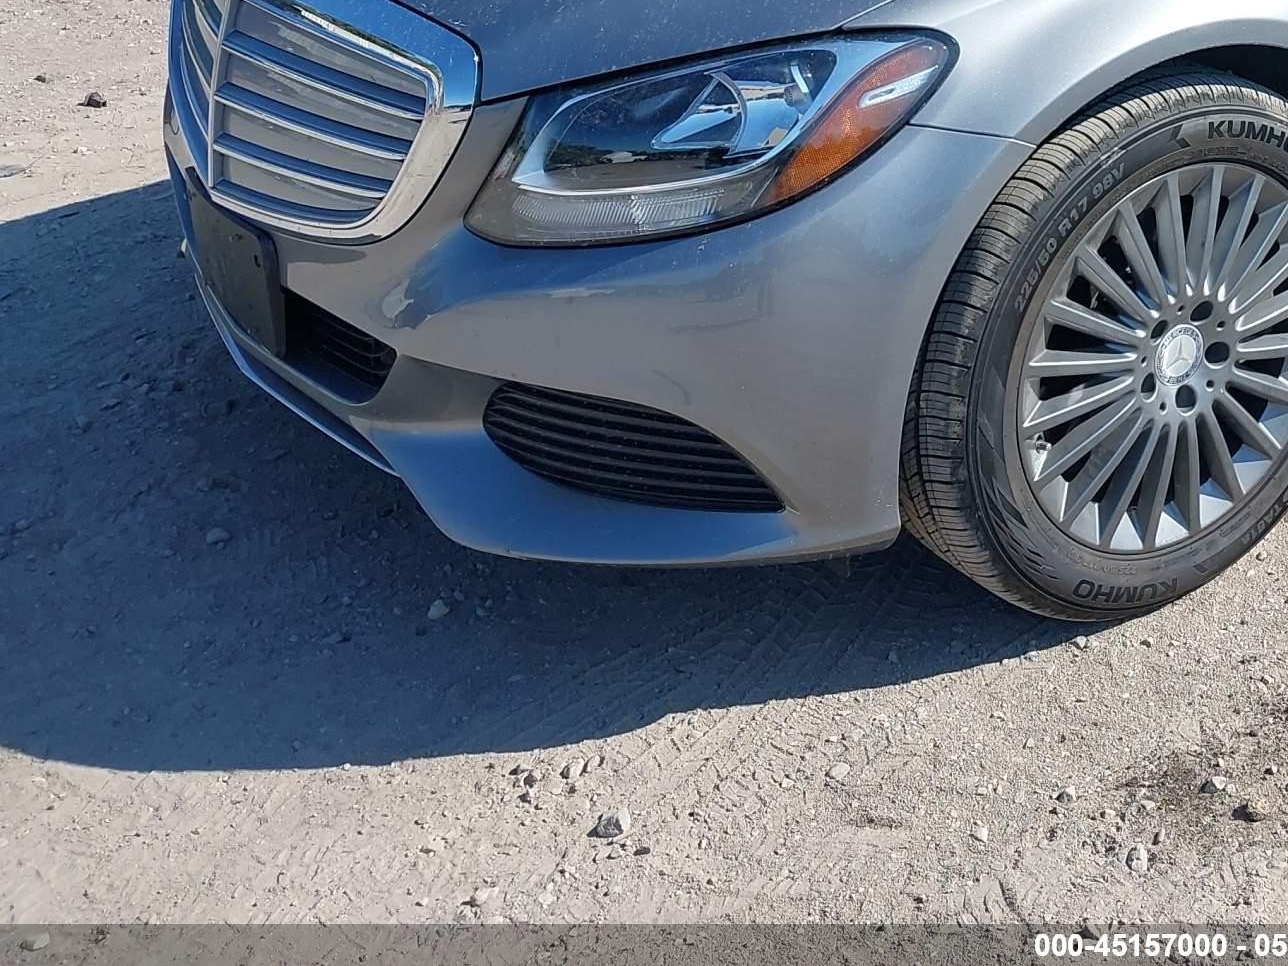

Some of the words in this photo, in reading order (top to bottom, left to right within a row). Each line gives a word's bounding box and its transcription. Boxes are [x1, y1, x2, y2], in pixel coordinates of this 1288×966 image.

[1014, 237, 1058, 313] 225/50
[1058, 199, 1089, 234] R17
[1091, 162, 1127, 201] 98V
[1072, 577, 1179, 604] KUMHO
